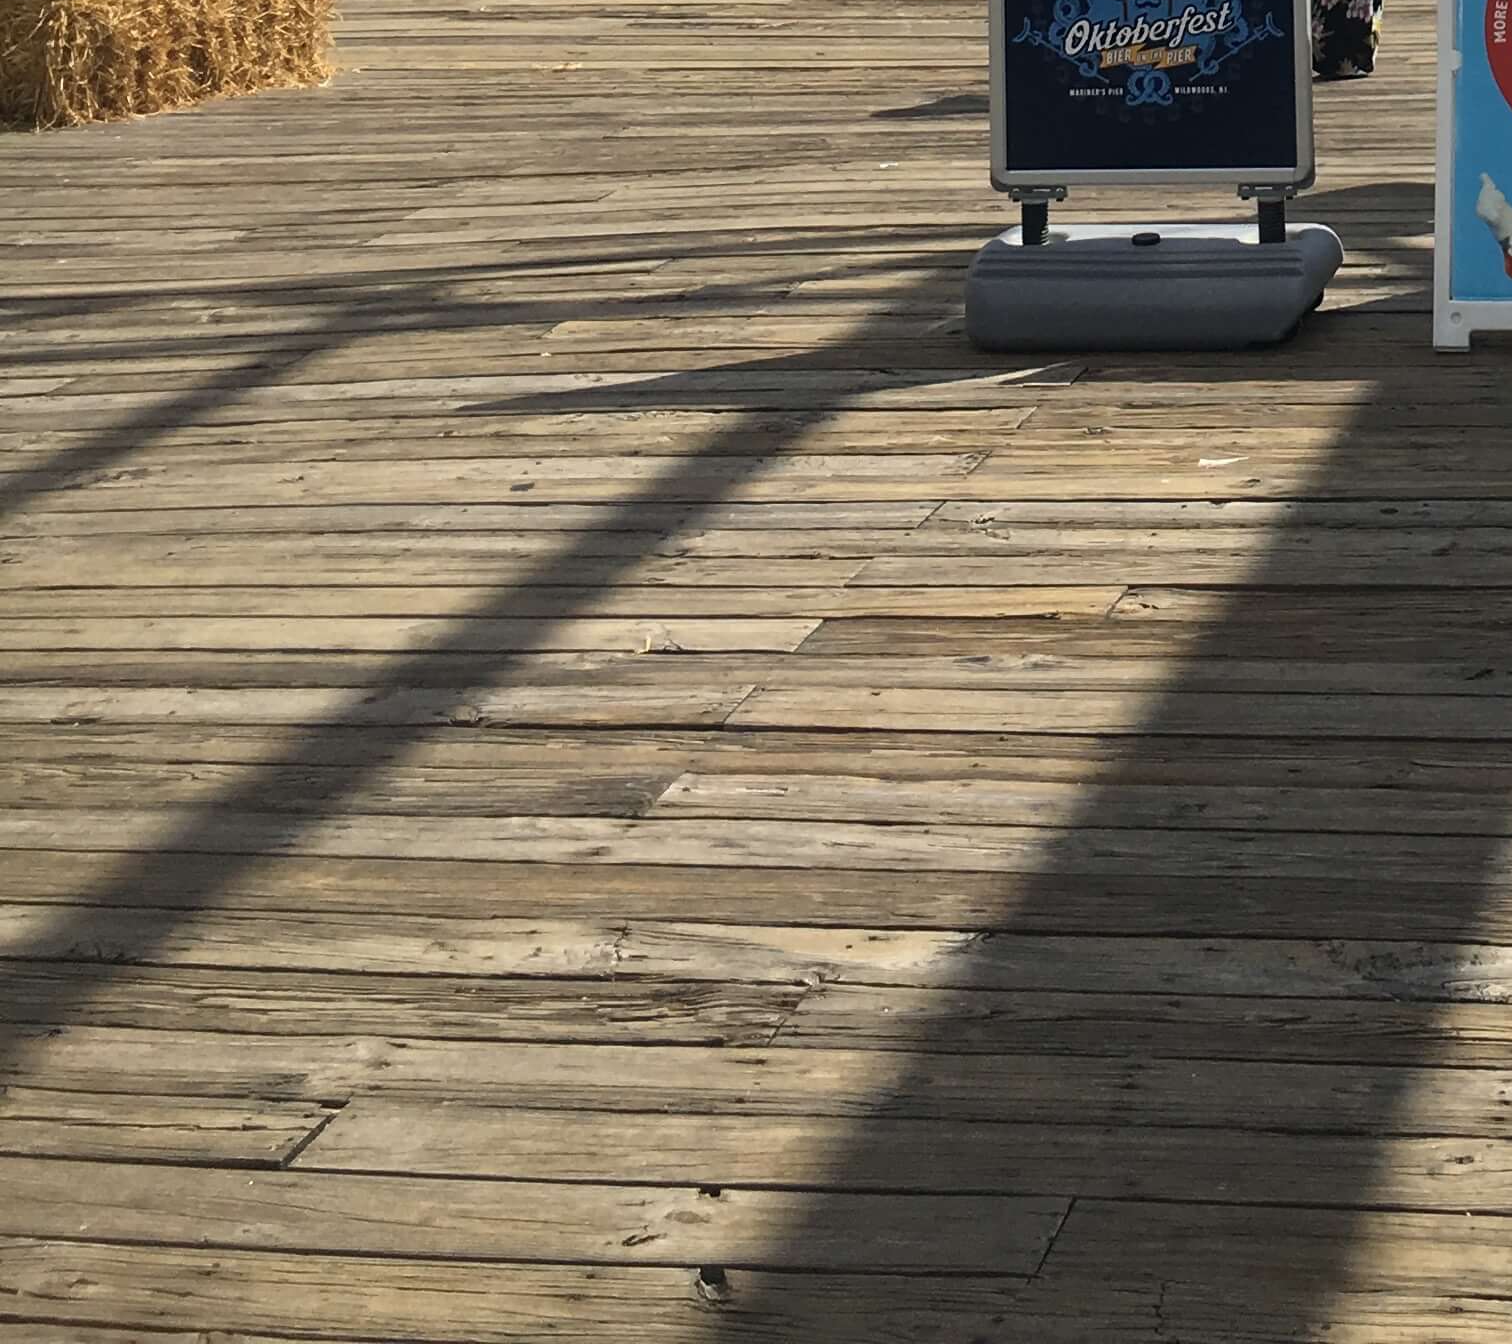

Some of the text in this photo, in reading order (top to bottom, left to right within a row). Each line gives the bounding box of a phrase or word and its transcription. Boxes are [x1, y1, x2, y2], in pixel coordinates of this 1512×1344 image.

[1065, 2, 1233, 55] Oktoberfest
[1106, 50, 1131, 64] BIER
[1167, 50, 1191, 64] PIER
